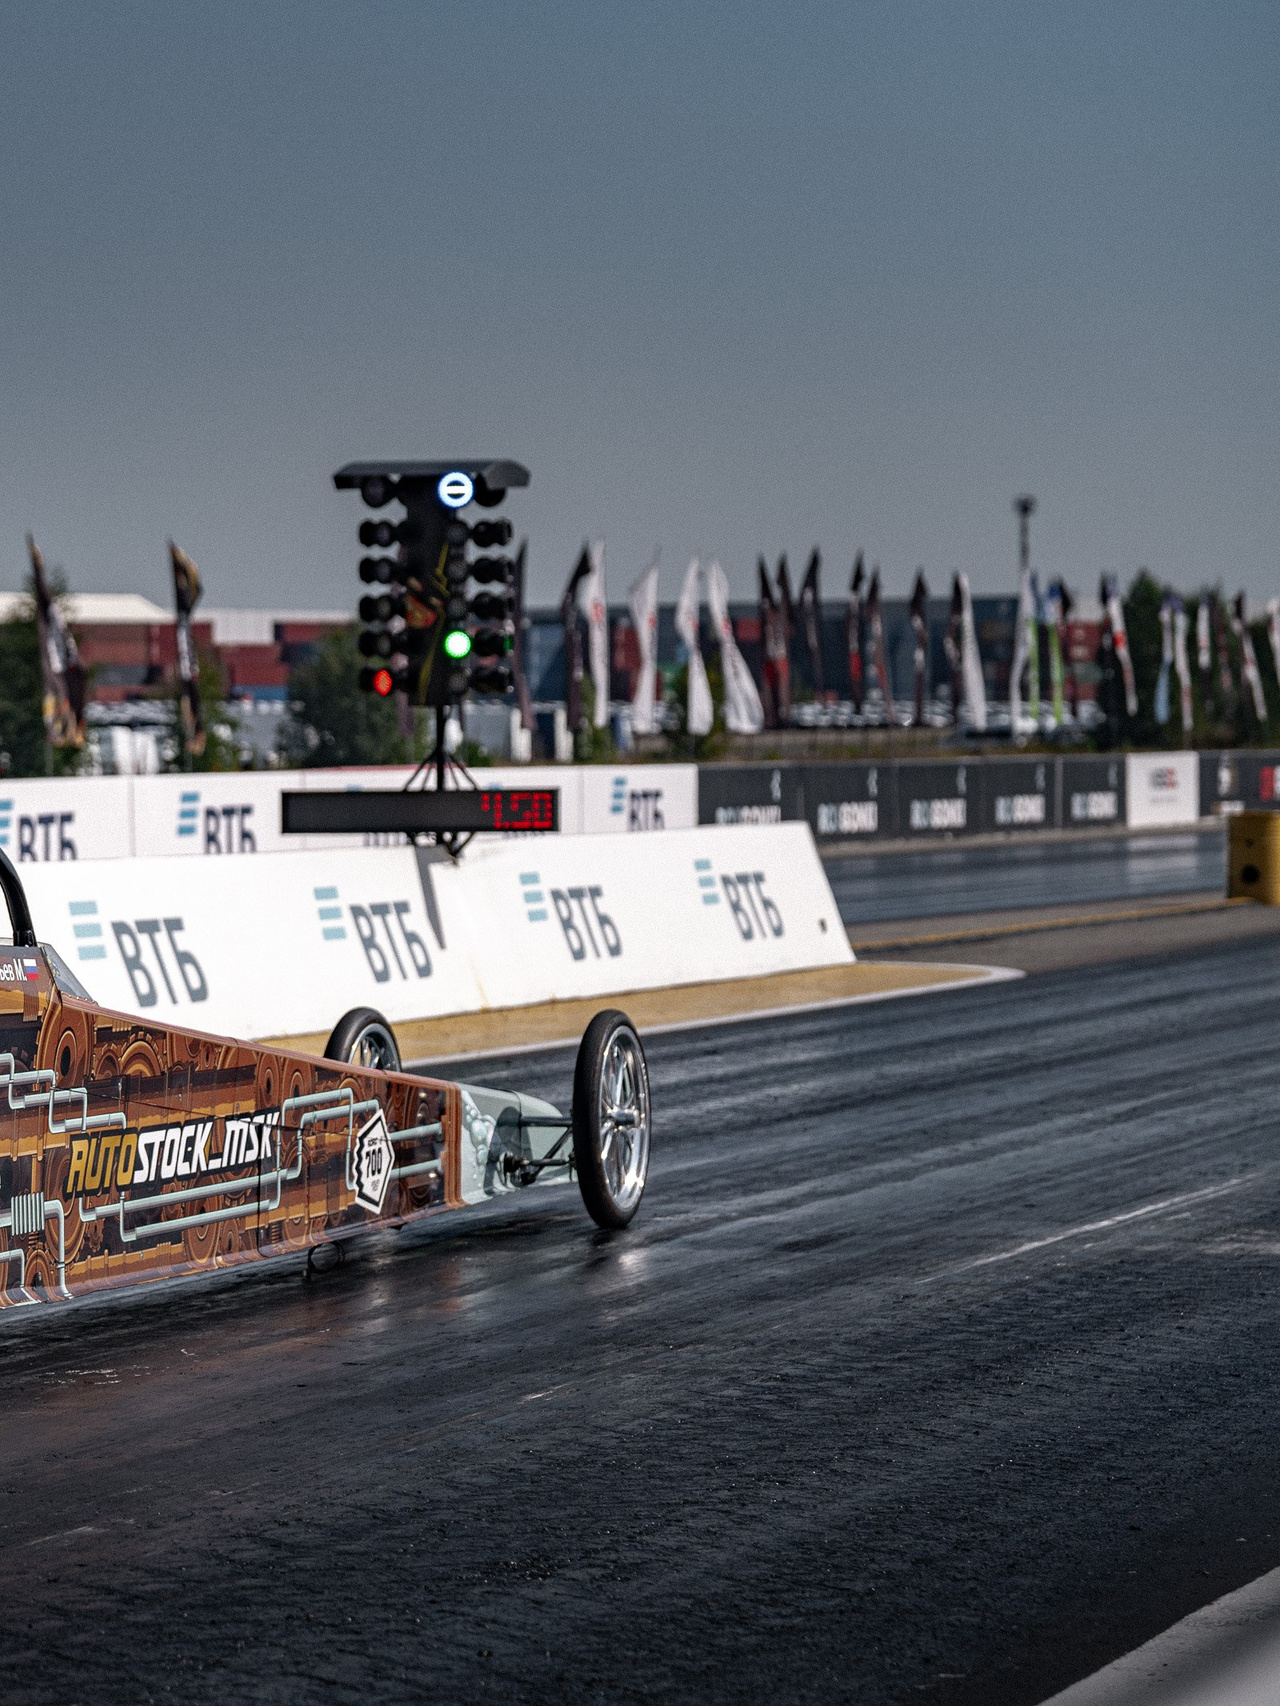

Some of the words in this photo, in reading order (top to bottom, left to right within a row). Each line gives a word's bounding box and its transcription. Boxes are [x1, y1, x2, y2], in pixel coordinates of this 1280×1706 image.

[349, 900, 433, 982] ВТБ
[550, 886, 623, 961] ВТБ
[721, 873, 784, 940] ВТБ
[111, 917, 209, 1007] ВТБ
[66, 1111, 280, 1193] AUTOSTOCK_MSK
[365, 1146, 382, 1178] 700
